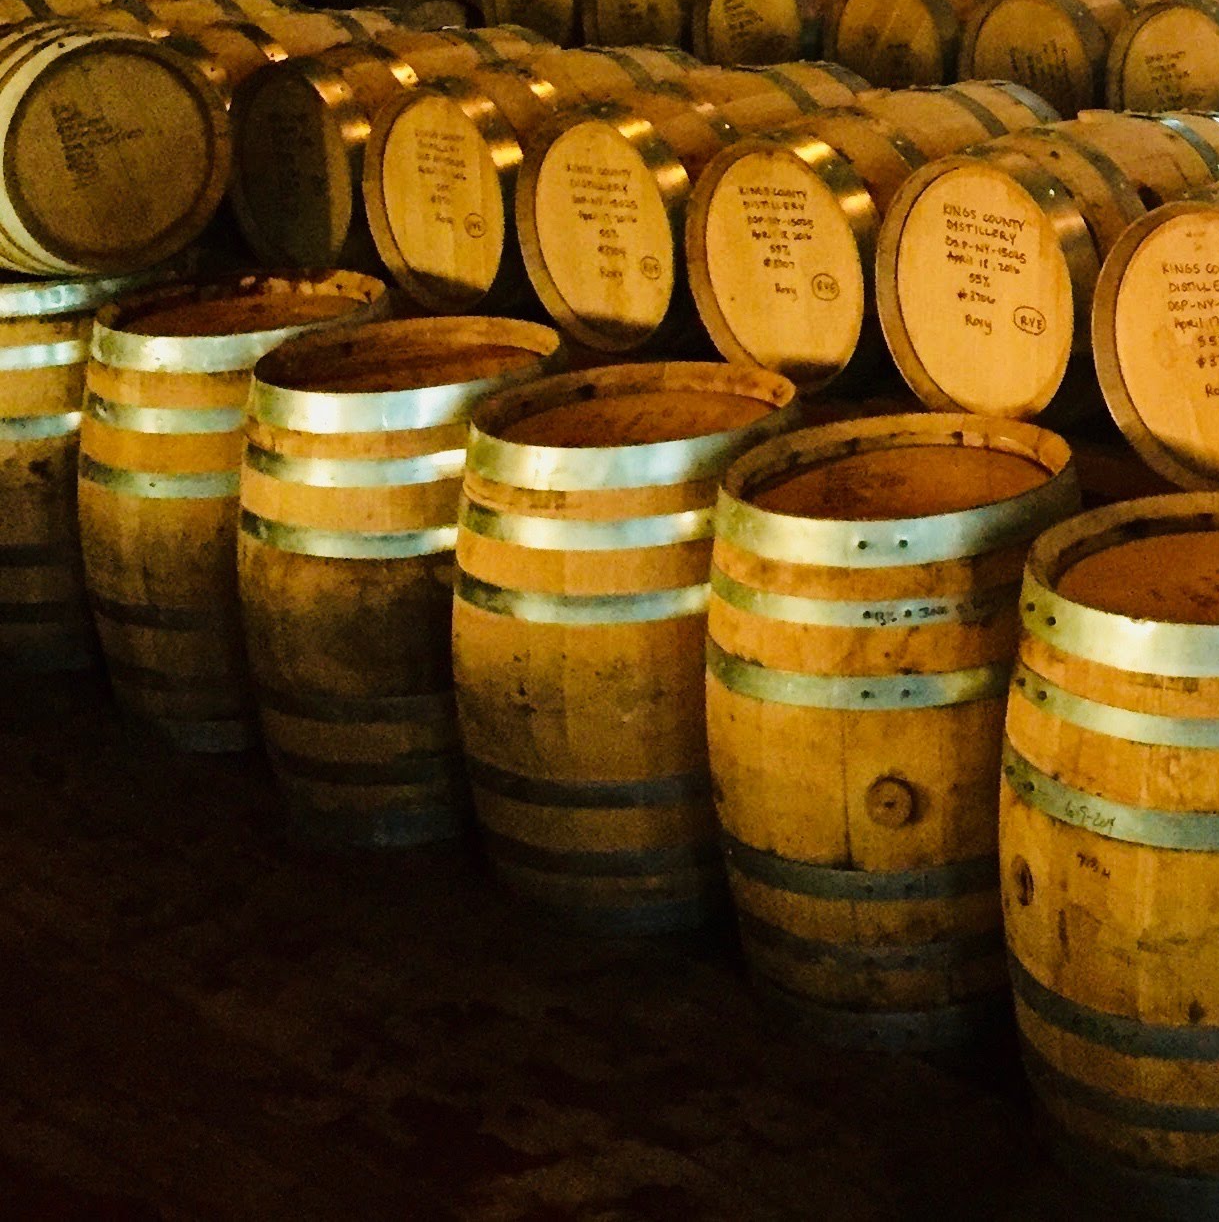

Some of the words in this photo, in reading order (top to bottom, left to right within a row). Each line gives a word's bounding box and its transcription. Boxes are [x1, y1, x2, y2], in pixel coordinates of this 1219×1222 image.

[943, 202, 977, 220] KINGS
[982, 212, 1026, 232] COUNTY
[946, 218, 1017, 246] DISTILLERY
[1161, 263, 1201, 276] KINGS
[964, 313, 993, 336] Roxy
